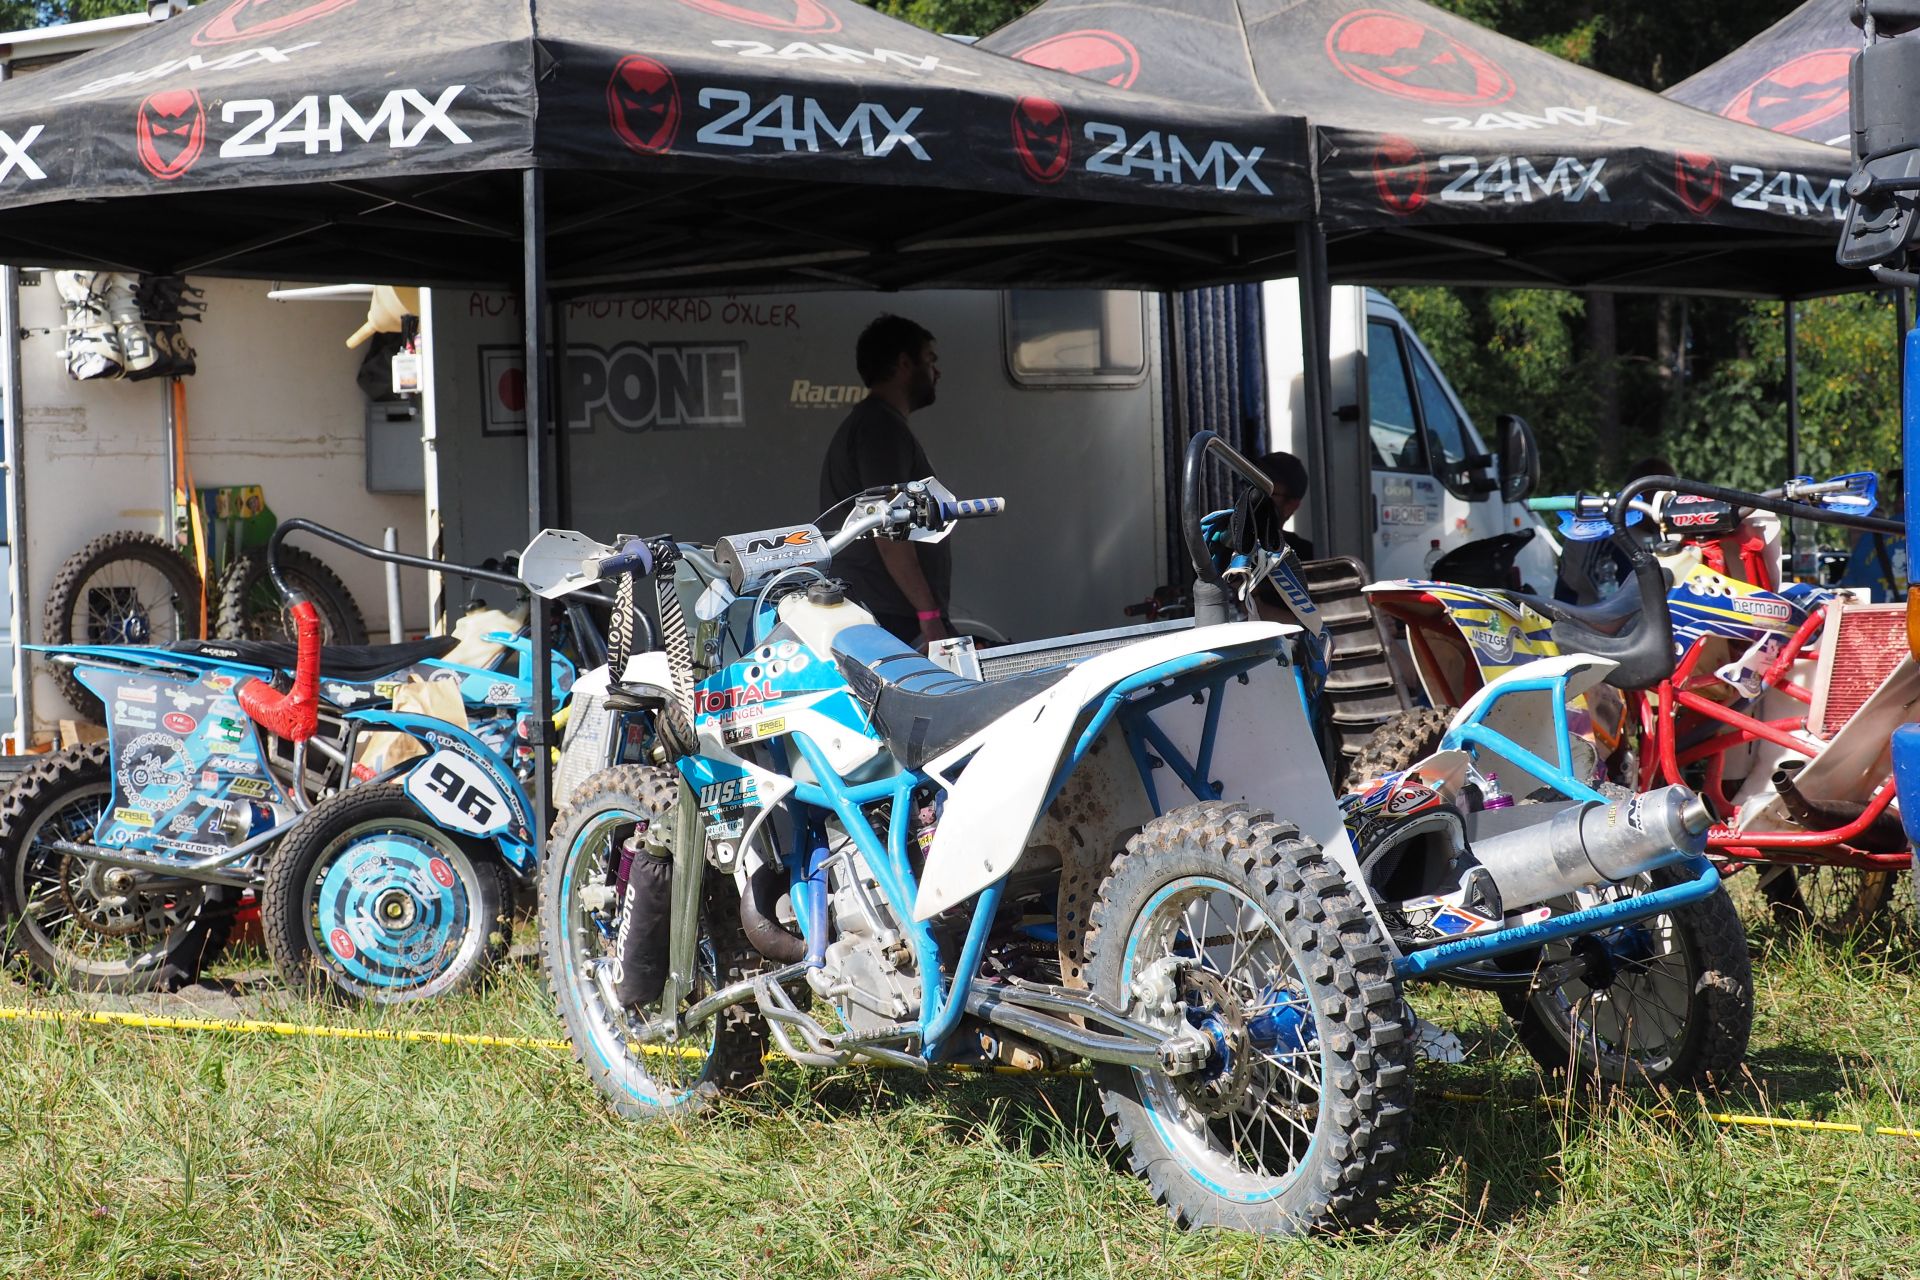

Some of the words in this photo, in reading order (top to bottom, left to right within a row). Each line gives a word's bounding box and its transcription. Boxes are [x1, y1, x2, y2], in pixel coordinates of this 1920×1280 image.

[220, 85, 472, 158] 24MX
[696, 88, 933, 161] 24MX
[1084, 122, 1273, 196] 24MX
[1438, 155, 1611, 203] 24MX
[755, 547, 811, 564] NEKEN
[1733, 599, 1787, 617] hermann
[694, 681, 783, 715] TOTAL
[425, 762, 497, 826] 96
